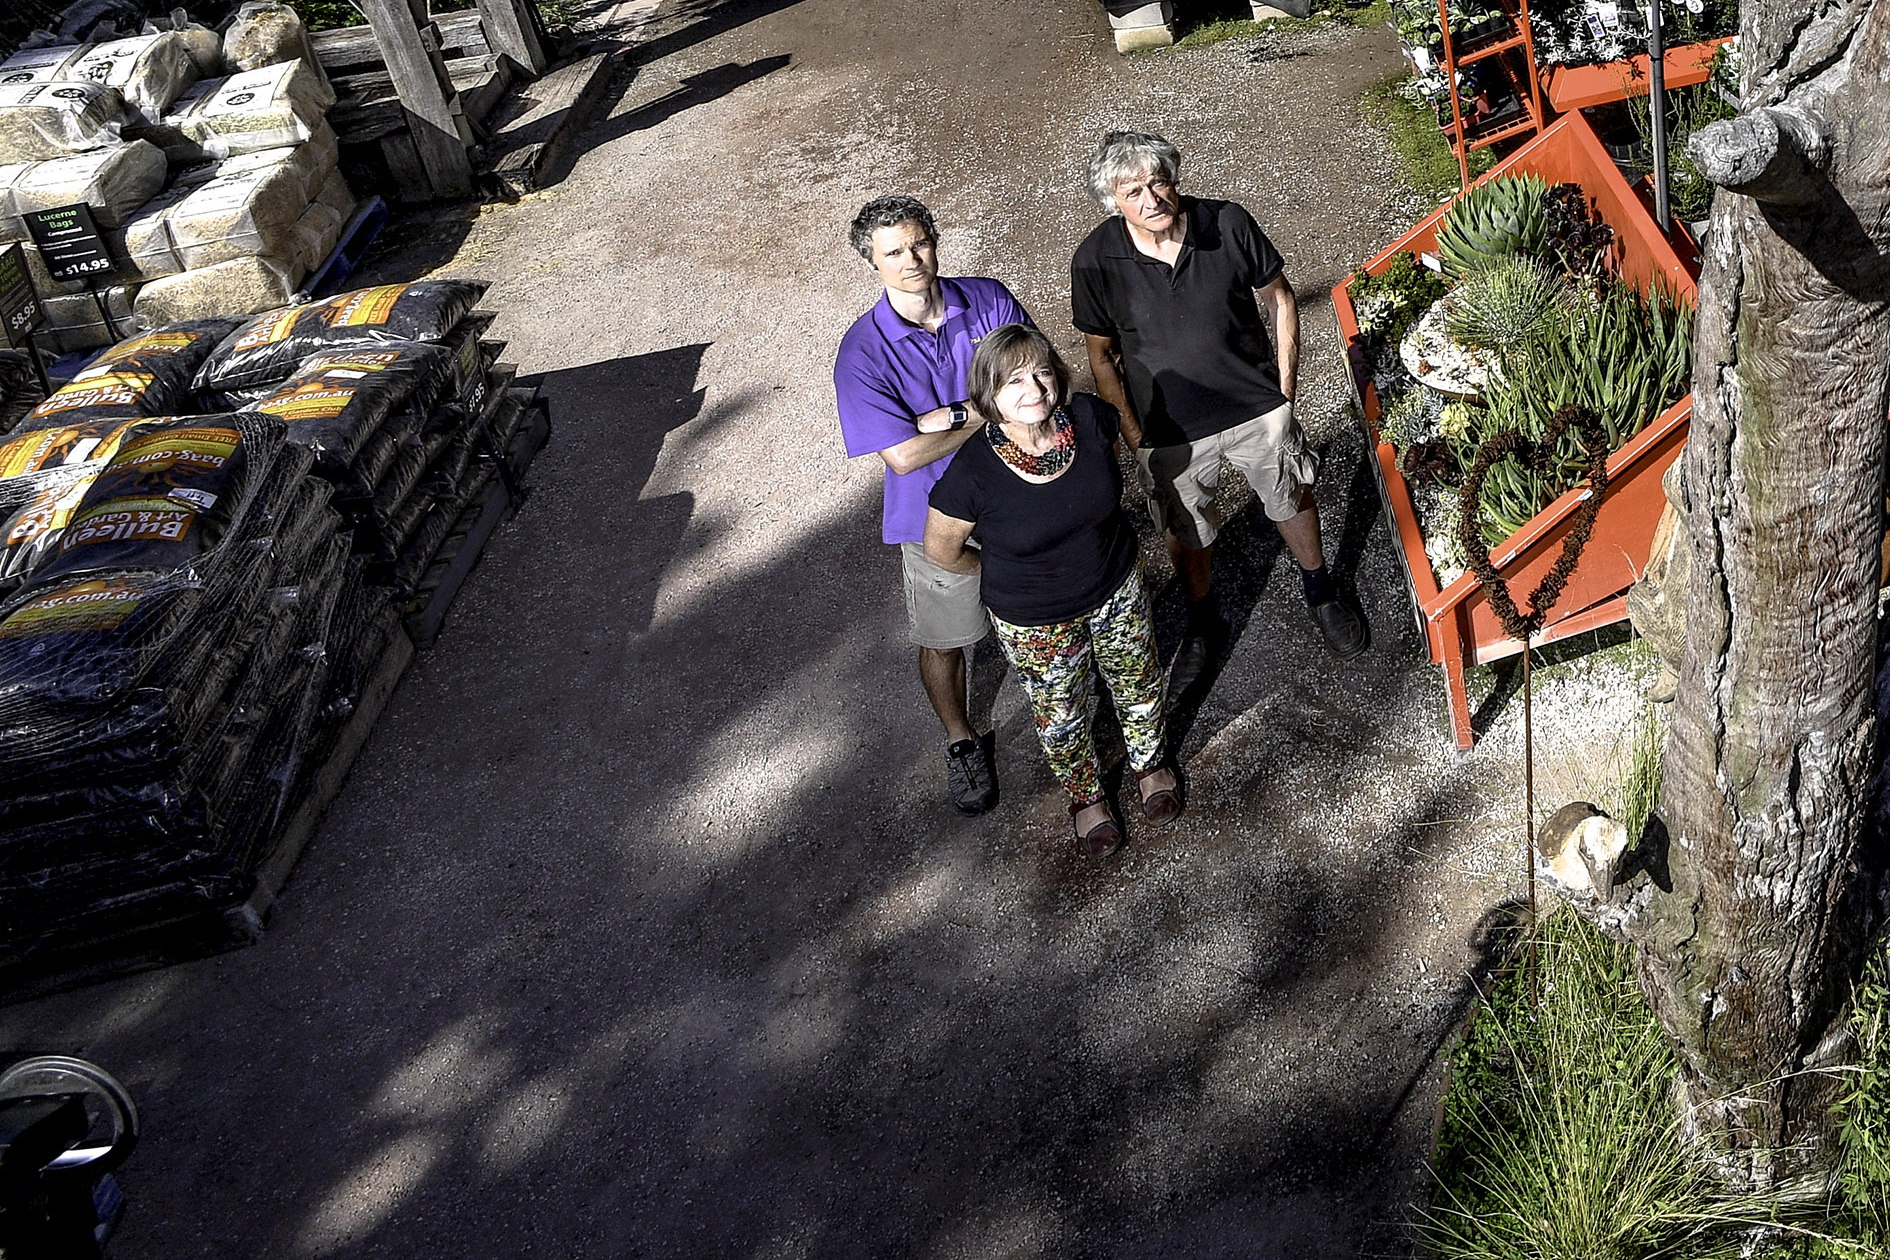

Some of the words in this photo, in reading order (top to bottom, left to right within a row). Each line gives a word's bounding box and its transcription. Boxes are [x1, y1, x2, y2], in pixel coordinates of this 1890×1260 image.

[37, 210, 77, 222] Lucerne
[48, 219, 74, 229] Bags
[65, 258, 110, 276] $14.95
[11, 300, 36, 330] $8.95
[37, 391, 136, 415] Bulleen
[138, 511, 150, 520] &
[153, 511, 190, 521] Art
[63, 521, 184, 550] Bulleen
